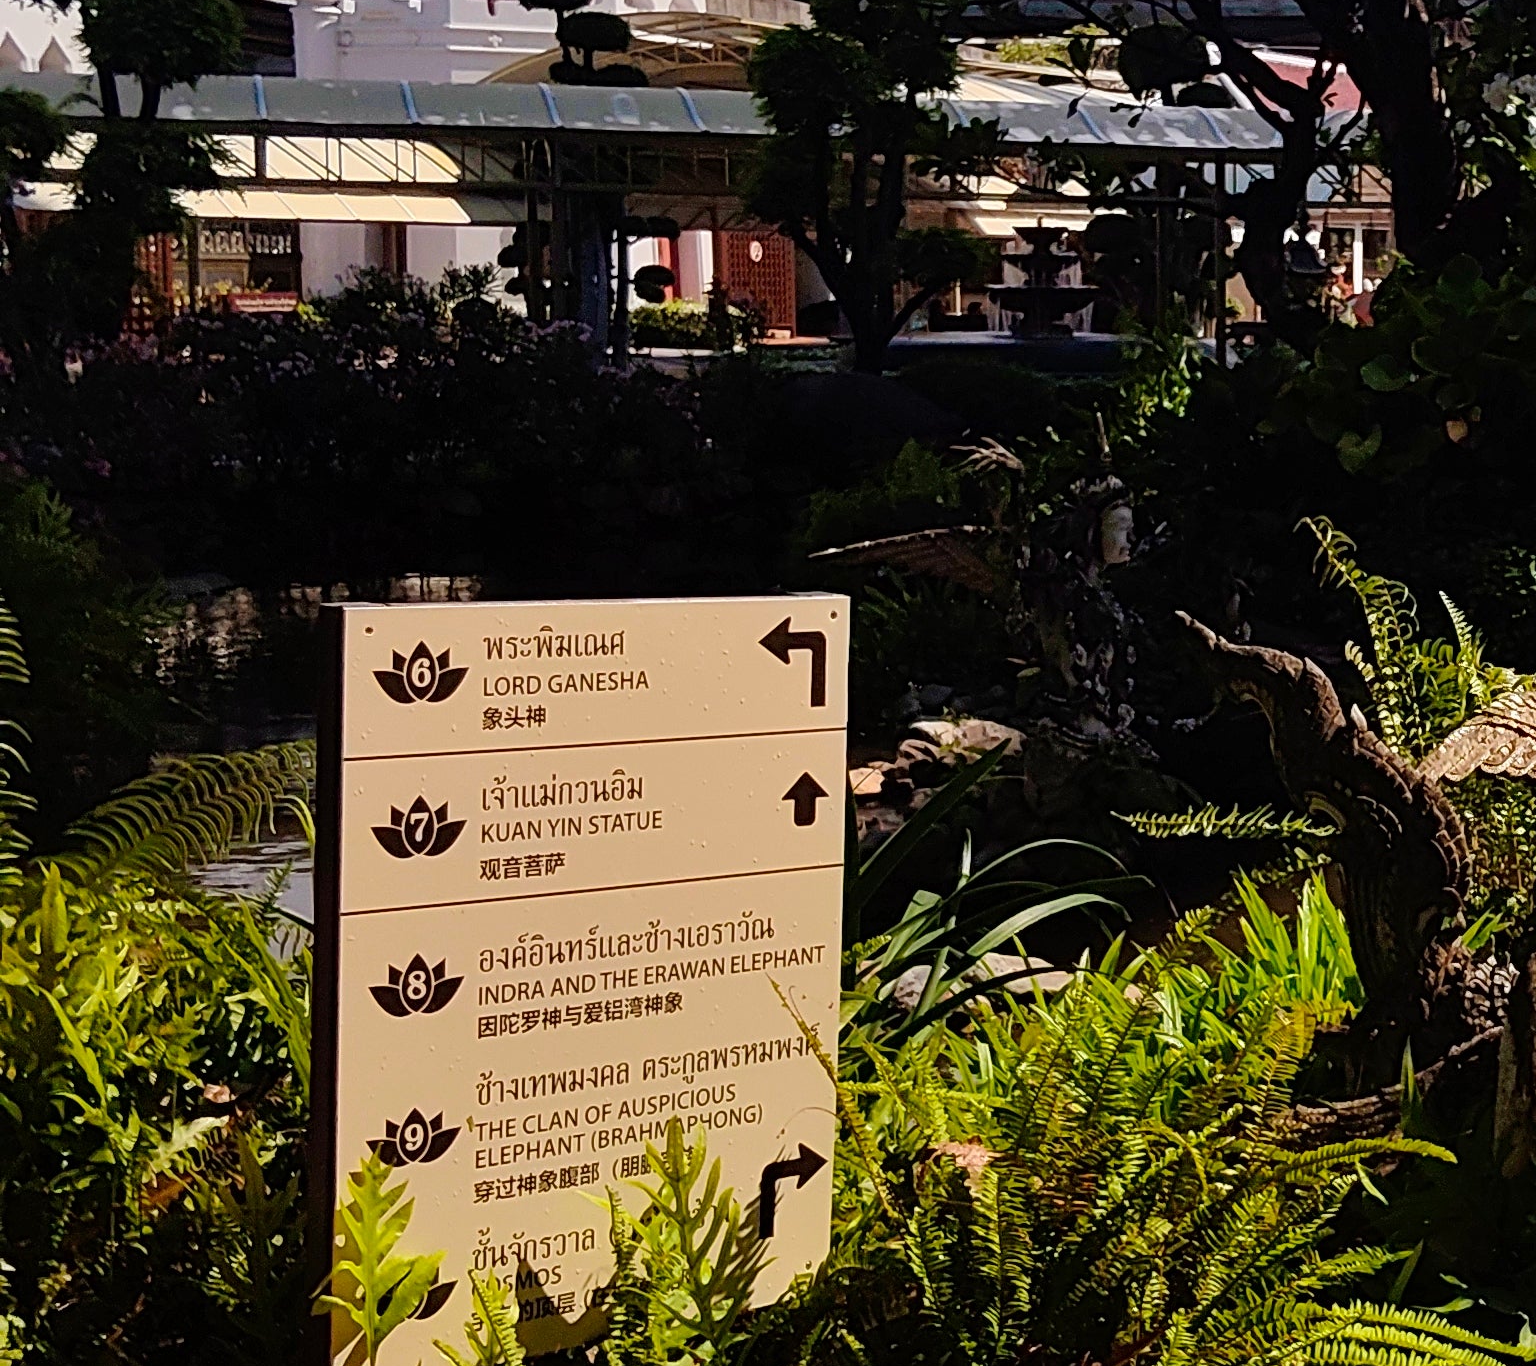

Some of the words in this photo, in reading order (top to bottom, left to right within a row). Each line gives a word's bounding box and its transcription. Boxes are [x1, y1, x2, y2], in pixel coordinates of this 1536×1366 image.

[410, 657, 432, 688] 6
[483, 675, 542, 697] LORD
[547, 670, 649, 694] GANESHA
[482, 704, 547, 731] 象头神
[481, 768, 643, 811] เจ้าแม่กวนอิม
[409, 812, 430, 842] 7
[481, 819, 542, 844] KUAN
[547, 816, 582, 838] YIN
[588, 810, 662, 835] STATUE
[479, 852, 566, 881] 观音菩萨
[479, 911, 775, 973] องค์อินทร์และช้างเอราวัณ
[406, 970, 427, 1000] 8
[478, 980, 545, 1006] INDRA
[550, 974, 596, 997] AND
[600, 968, 638, 991] THE
[644, 957, 725, 985] ERAWAN
[730, 945, 826, 974] ELEPHANT
[478, 991, 683, 1039] 因陀罗神与爱铝湾神象
[476, 1062, 629, 1107] ช้างเทพมงคล
[475, 1118, 517, 1142] THE
[522, 1108, 578, 1135] CLAN
[585, 1103, 612, 1126] OF
[618, 1084, 736, 1120] AUSPICIOUS
[404, 1123, 424, 1151] 9
[475, 1133, 586, 1169] ELEPHANT
[472, 1227, 595, 1271] ชั้นจักรวาล
[472, 1265, 562, 1295] SMOS
